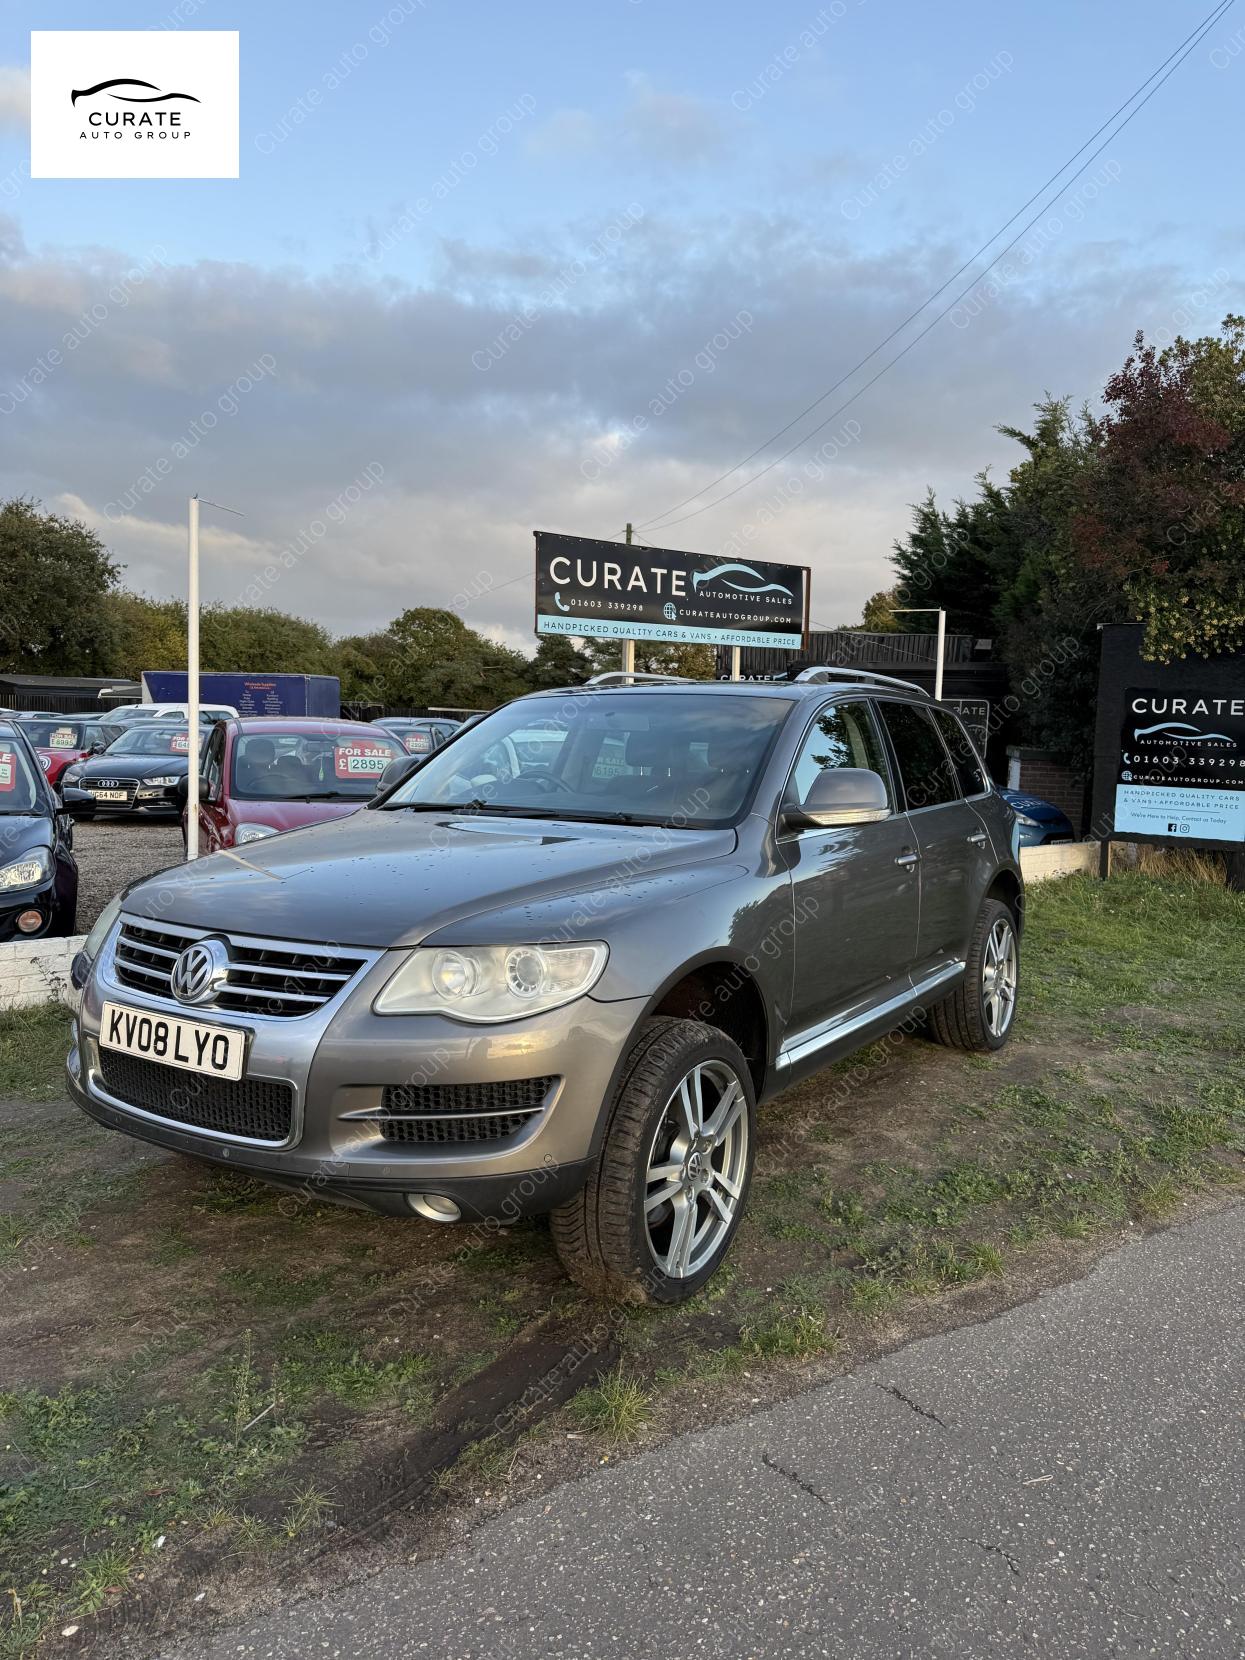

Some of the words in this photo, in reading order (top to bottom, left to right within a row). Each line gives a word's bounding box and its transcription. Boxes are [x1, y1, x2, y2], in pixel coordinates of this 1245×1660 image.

[549, 556, 687, 597] CURATE
[699, 590, 761, 602] AUTOMOTIVE
[765, 596, 793, 605] SALES
[570, 598, 602, 608] 01603
[608, 602, 644, 612] 339298
[679, 609, 792, 624] CURATEAUTOGROUP.COM
[544, 621, 609, 634] HANDPICKED
[612, 626, 653, 637] QUALITY
[656, 630, 678, 638] CARS
[690, 632, 712, 640] VANS
[720, 634, 770, 644] AFFORDABLE
[773, 637, 796, 646] PRICE
[1131, 698, 1245, 716] CURATE
[338, 748, 362, 756] FOR
[364, 748, 392, 756] SALE
[352, 759, 384, 770] 2895
[1134, 756, 1180, 765] 01603
[1188, 758, 1245, 767] 339298
[1133, 774, 1244, 785] CURATEAUTOGROUP.COM
[1124, 790, 1176, 798] HANDPICKED
[1159, 800, 1211, 808] AFFORDABLE
[109, 1008, 169, 1057] KV08
[174, 1026, 230, 1071] LYO
